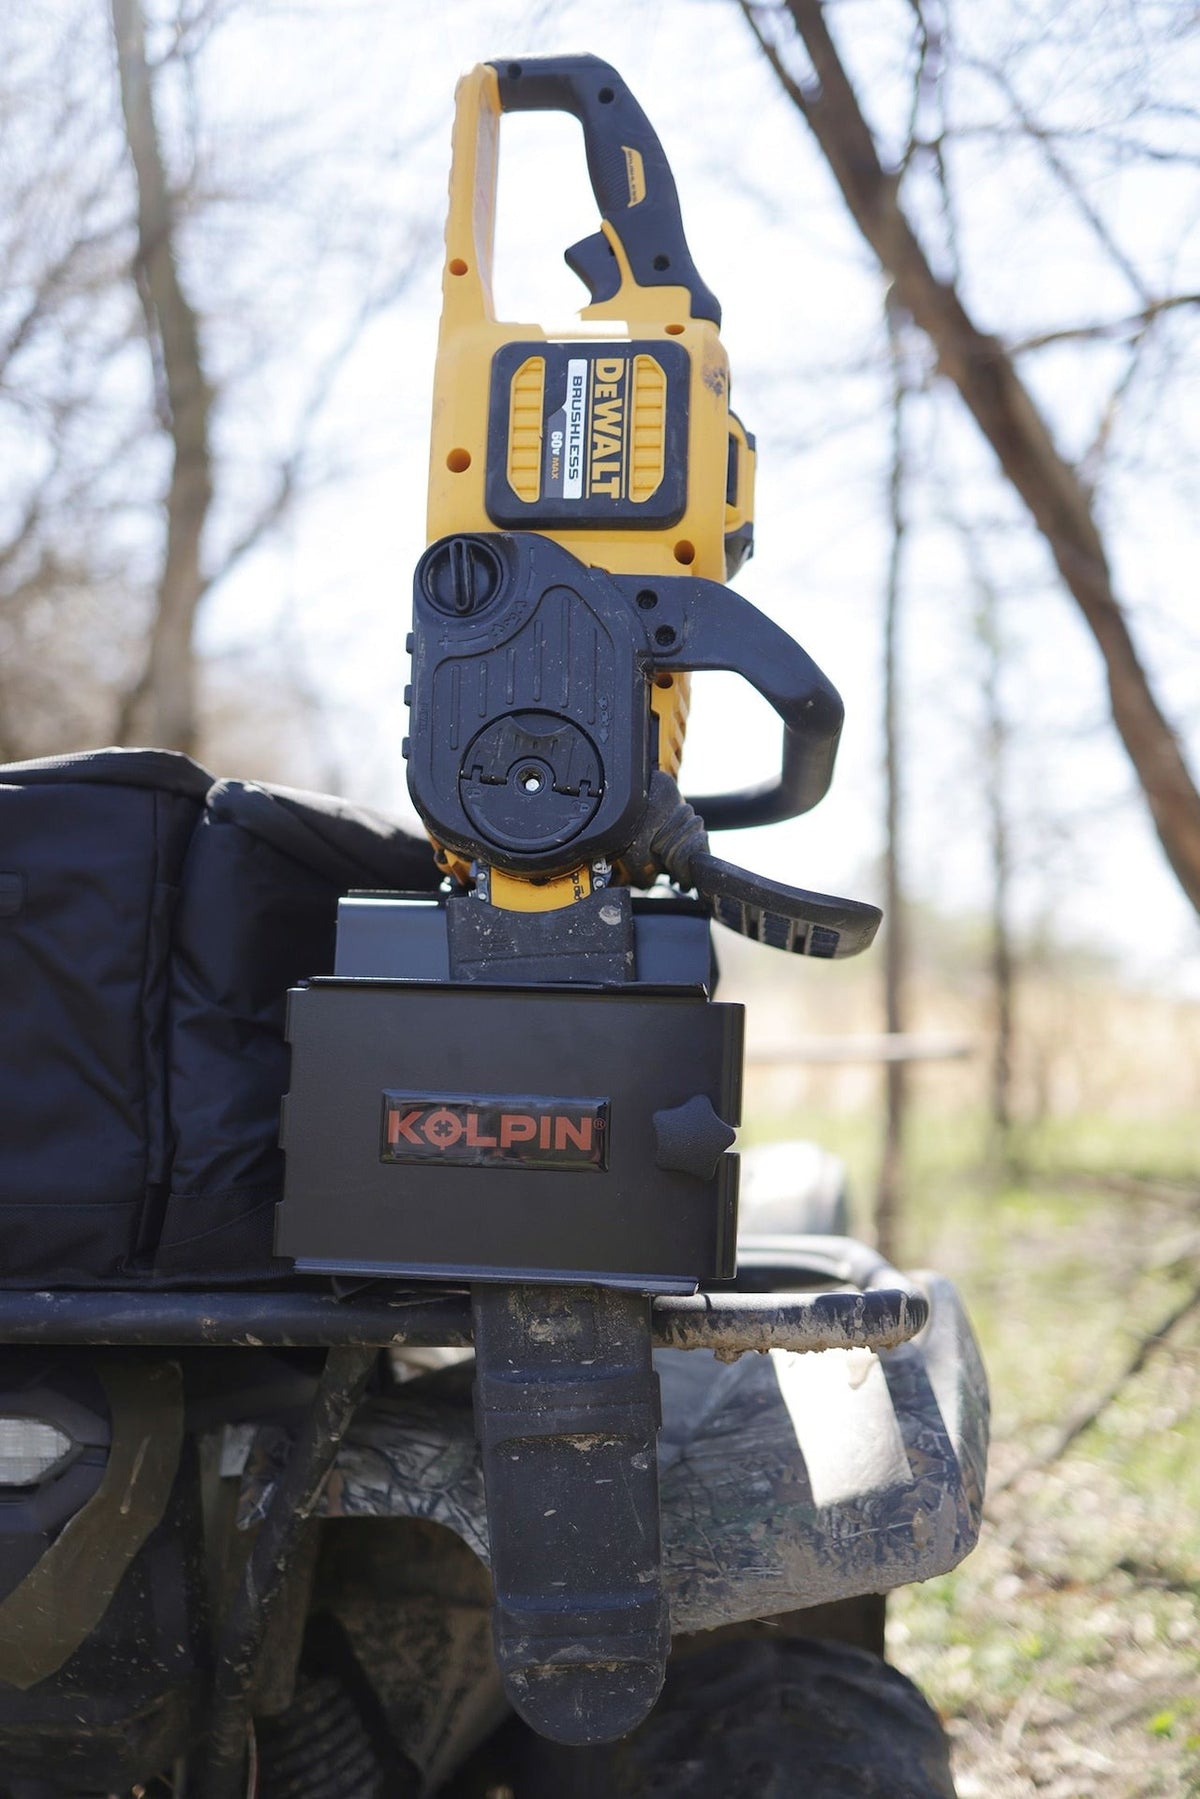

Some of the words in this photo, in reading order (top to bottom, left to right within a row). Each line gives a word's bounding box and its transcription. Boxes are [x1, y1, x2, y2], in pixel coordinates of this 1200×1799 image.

[551, 457, 560, 479] MAX
[568, 375, 583, 480] BRUSHLESS
[591, 358, 625, 499] DEWALT
